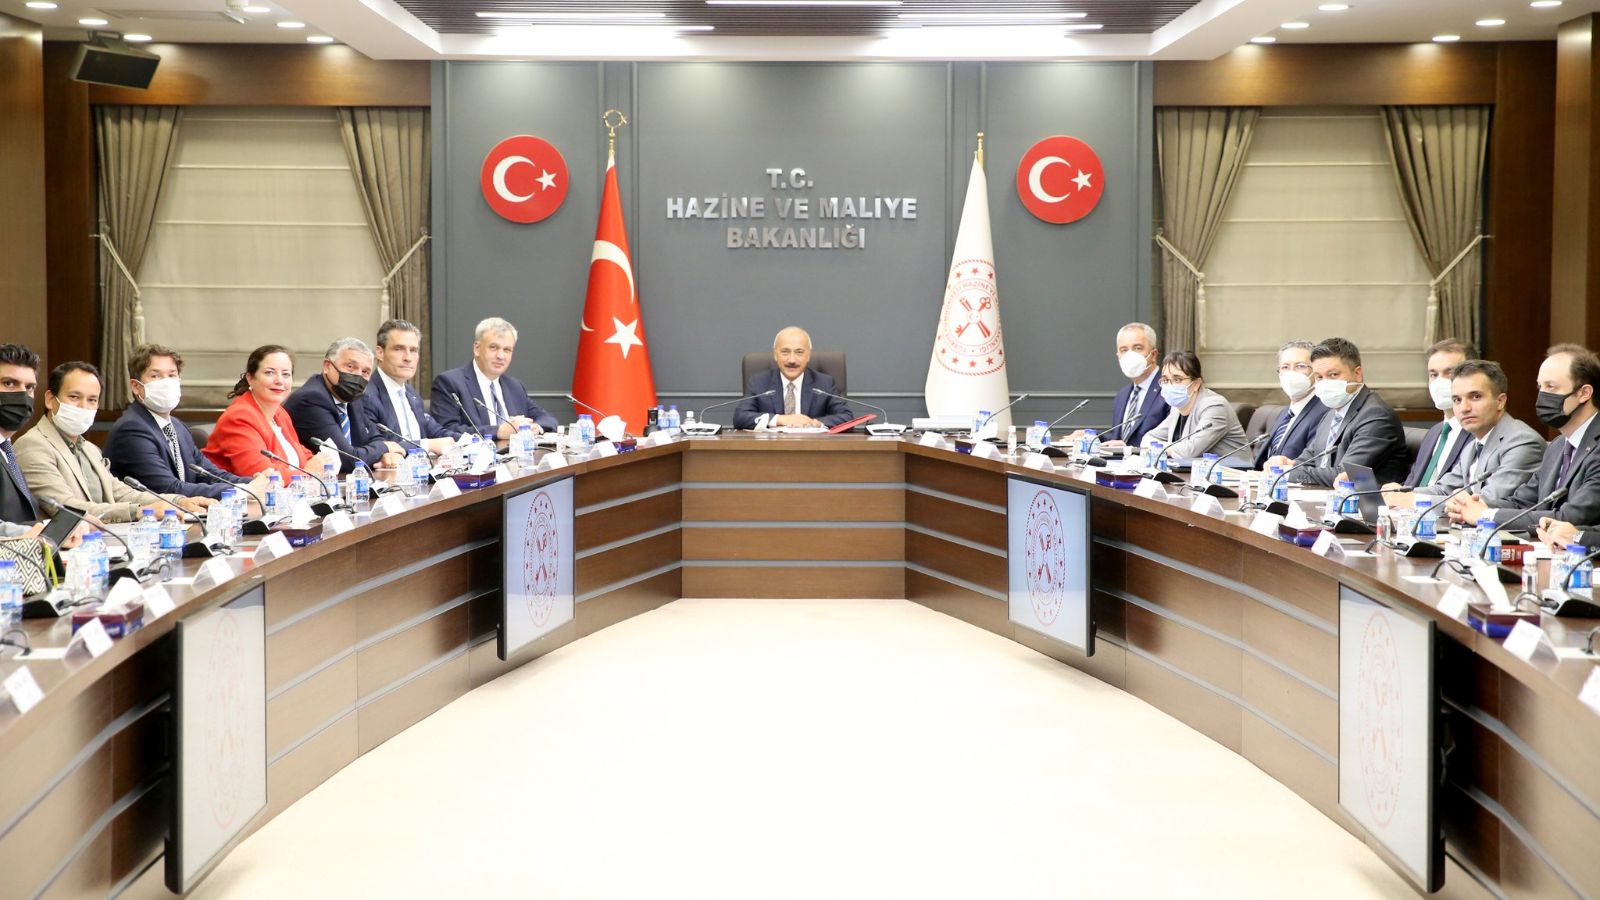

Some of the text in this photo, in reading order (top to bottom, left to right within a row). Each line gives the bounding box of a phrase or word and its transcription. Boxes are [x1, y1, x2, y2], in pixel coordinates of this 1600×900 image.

[766, 168, 814, 189] T.C.
[666, 192, 918, 219] HAZİNE VE MALİYE
[727, 223, 865, 249] BAKANLIĞI
